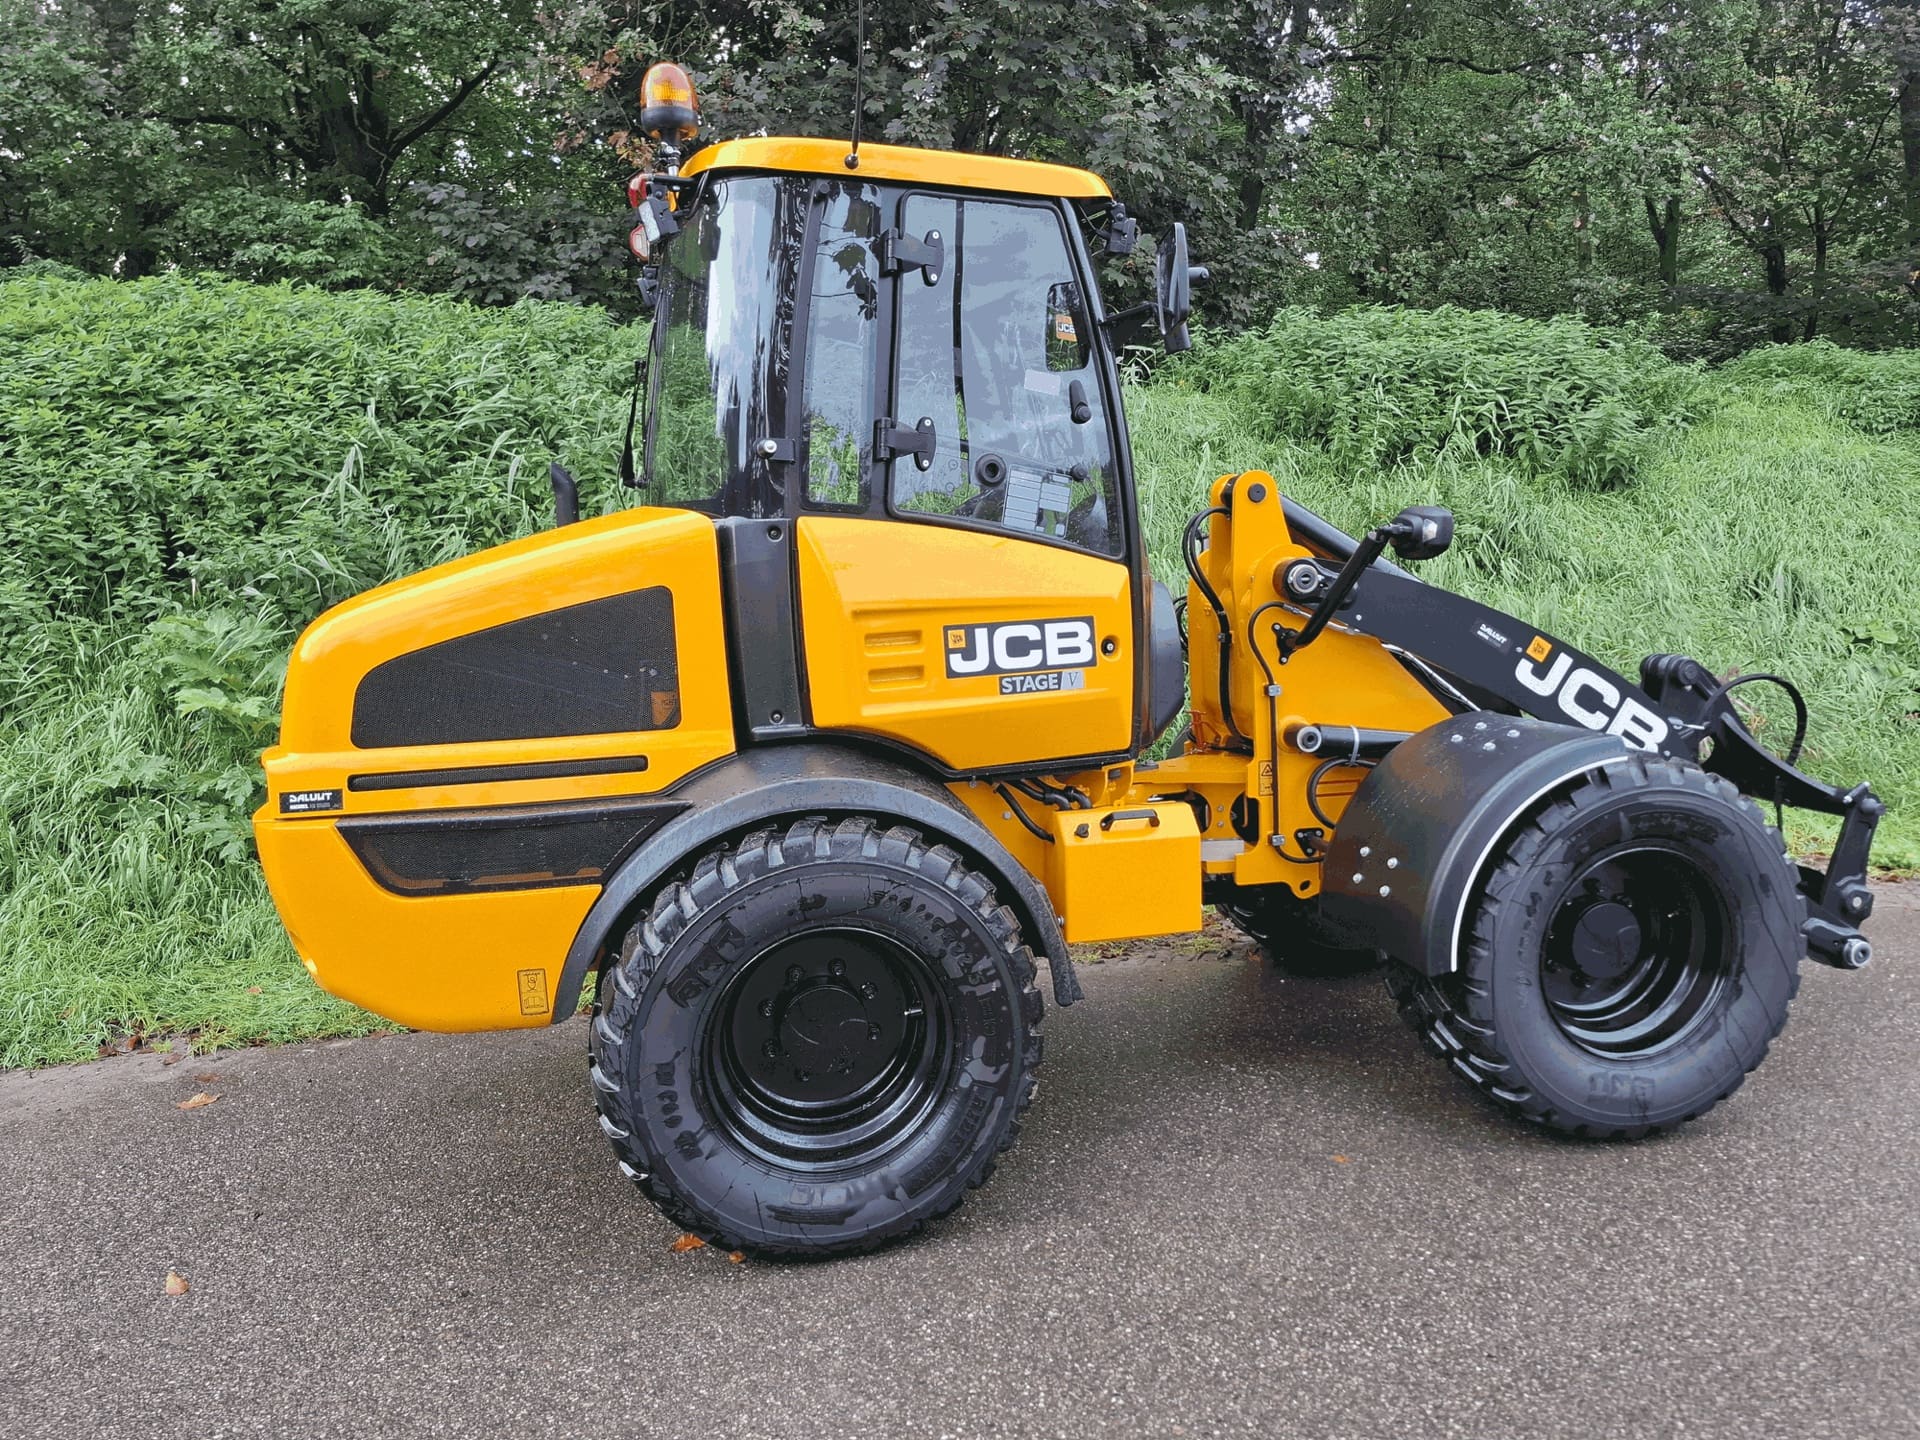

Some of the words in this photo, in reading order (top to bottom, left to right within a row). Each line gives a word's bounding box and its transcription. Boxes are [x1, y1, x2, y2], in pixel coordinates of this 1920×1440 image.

[948, 620, 1094, 674] JCB
[1001, 674, 1059, 693] STAGE
[1068, 671, 1079, 687] V
[1515, 652, 1668, 753] JCB
